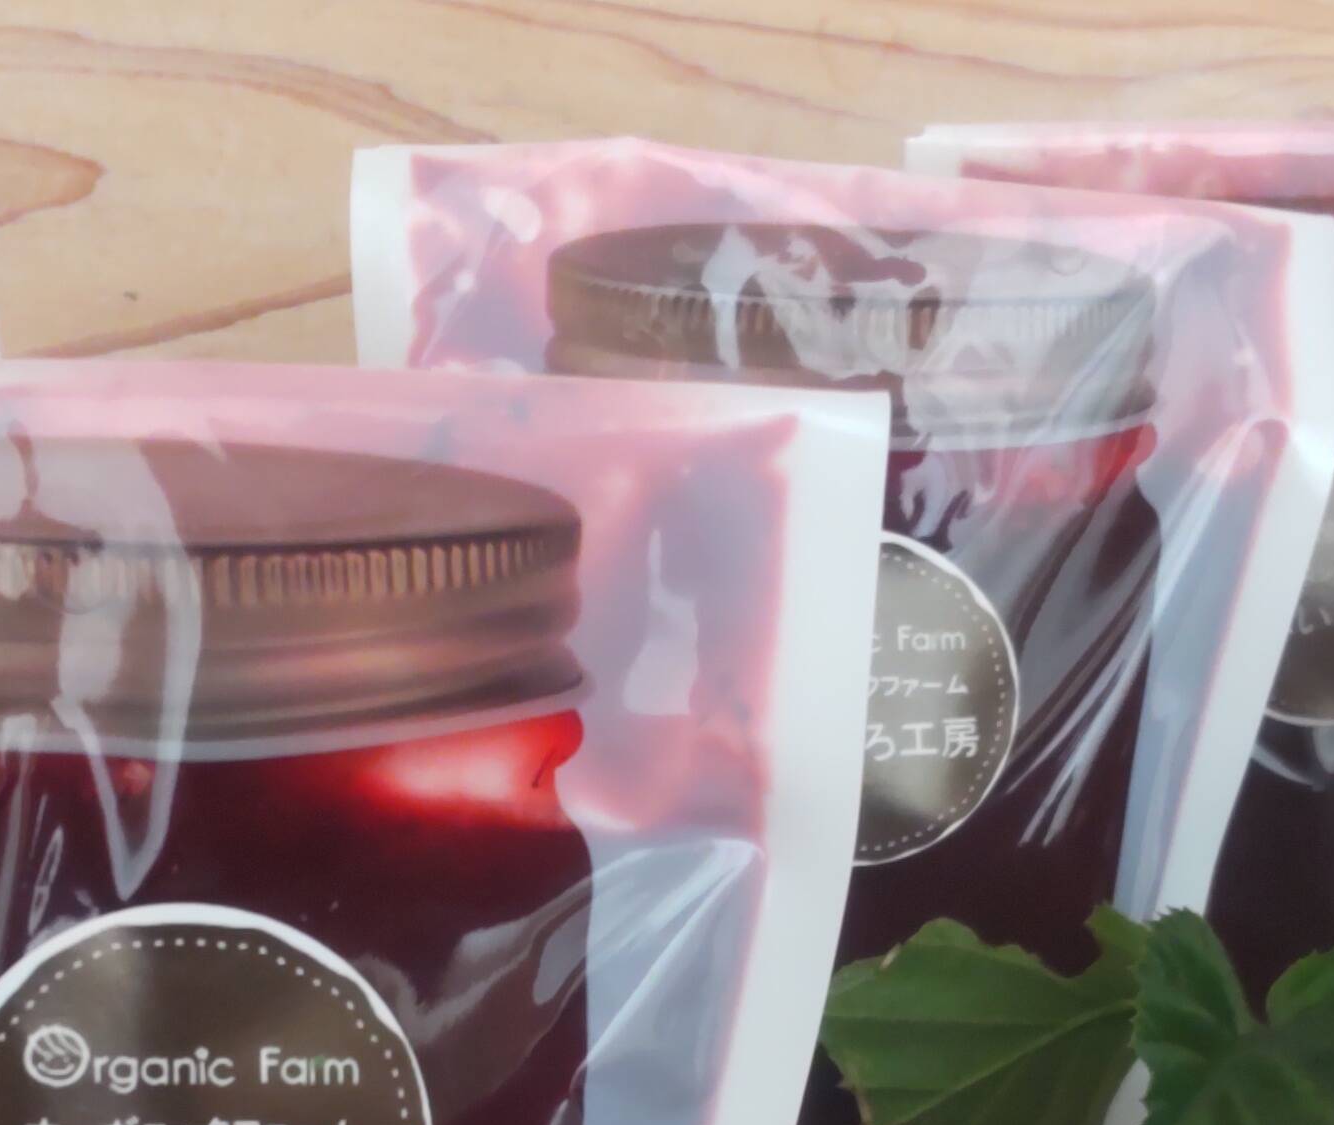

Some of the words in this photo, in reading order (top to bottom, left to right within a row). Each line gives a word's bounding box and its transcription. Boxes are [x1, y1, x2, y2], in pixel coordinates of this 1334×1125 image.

[897, 625, 967, 652] Farm
[864, 717, 981, 762] ろ工房
[24, 1025, 236, 1094] Organic
[260, 1046, 360, 1085] Farm
